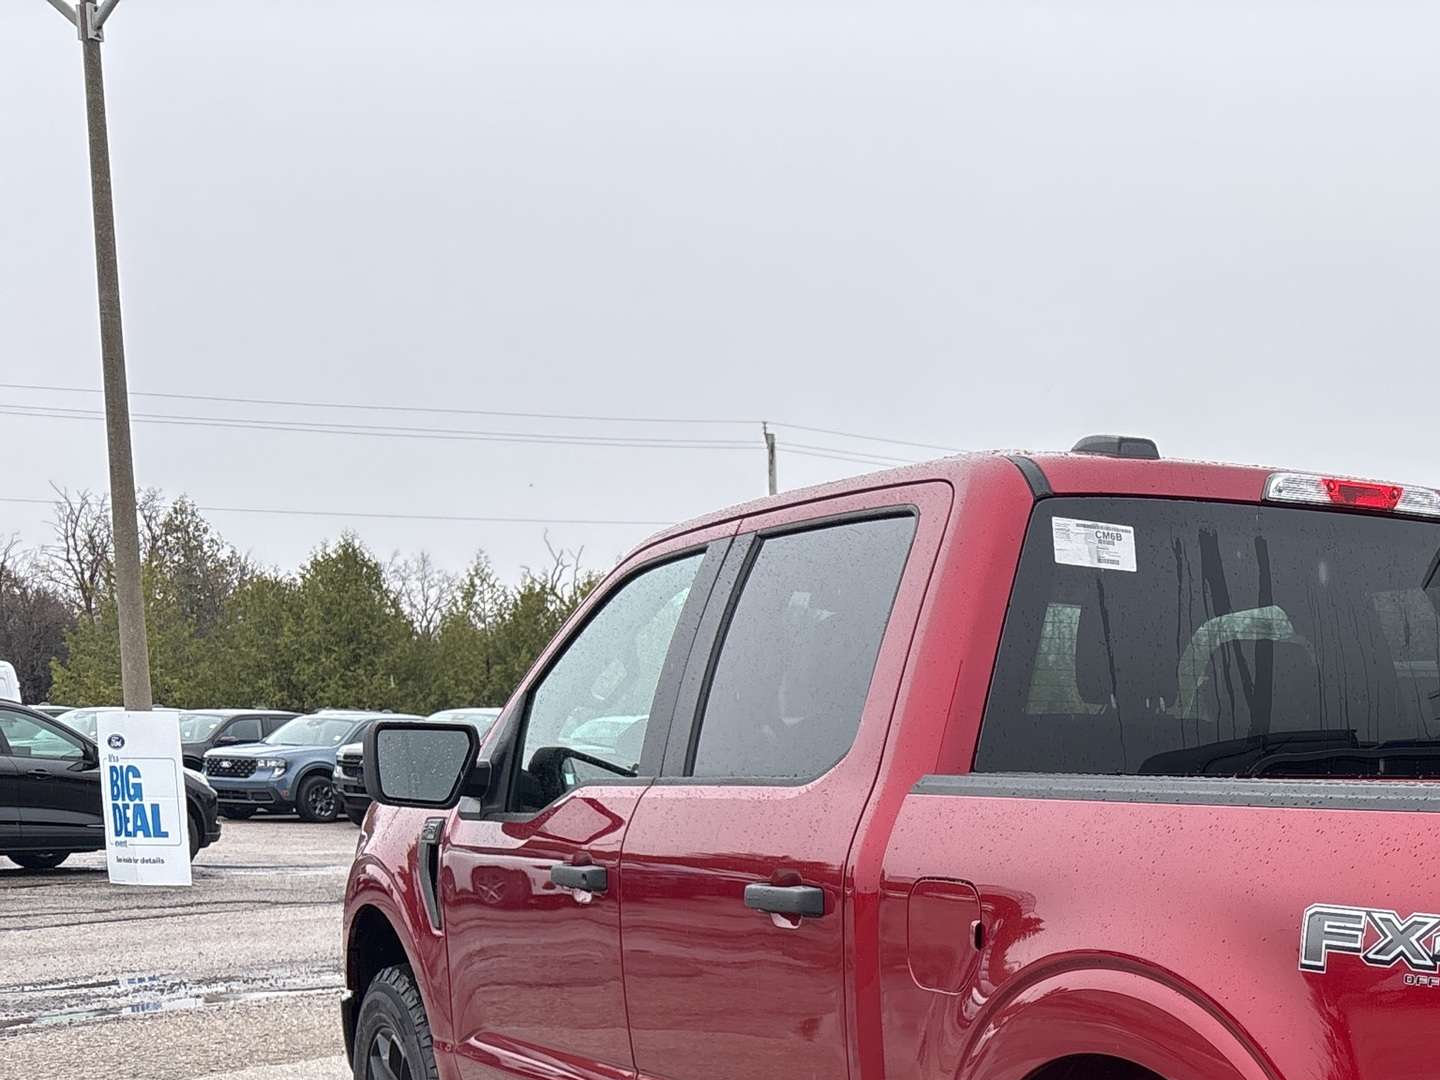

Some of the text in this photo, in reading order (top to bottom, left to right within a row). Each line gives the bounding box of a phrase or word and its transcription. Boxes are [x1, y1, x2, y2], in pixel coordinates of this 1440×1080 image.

[109, 765, 143, 801] BIG
[112, 803, 169, 838] DEAL
[1403, 973, 1440, 988] OFF
